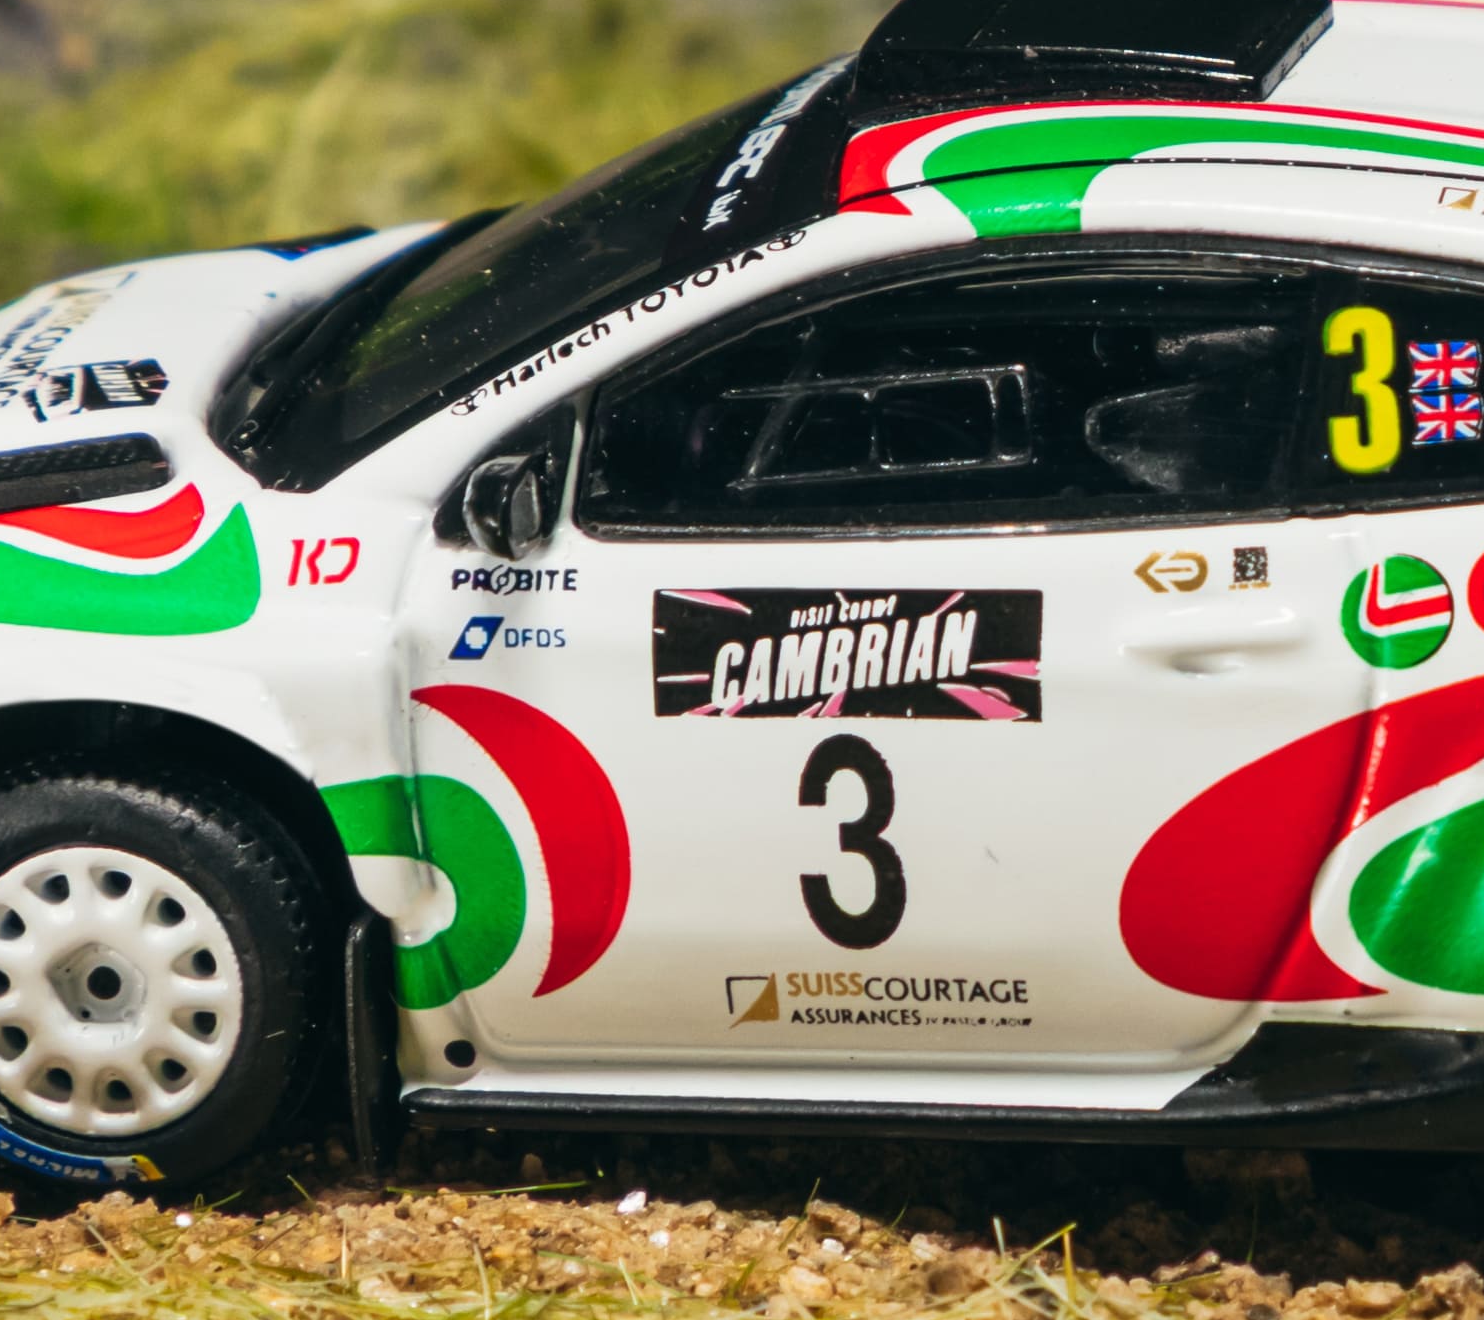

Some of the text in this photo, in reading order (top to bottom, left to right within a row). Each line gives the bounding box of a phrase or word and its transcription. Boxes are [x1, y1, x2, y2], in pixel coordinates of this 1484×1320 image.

[620, 250, 765, 322] TOYOTA
[1323, 305, 1401, 475] 3
[504, 627, 566, 648] DFDS
[710, 609, 977, 709] CAMBRIAN
[798, 732, 907, 950] 3
[786, 972, 1029, 1004] SUISSCOURTAGE
[790, 1008, 923, 1026] ASSURANCES
